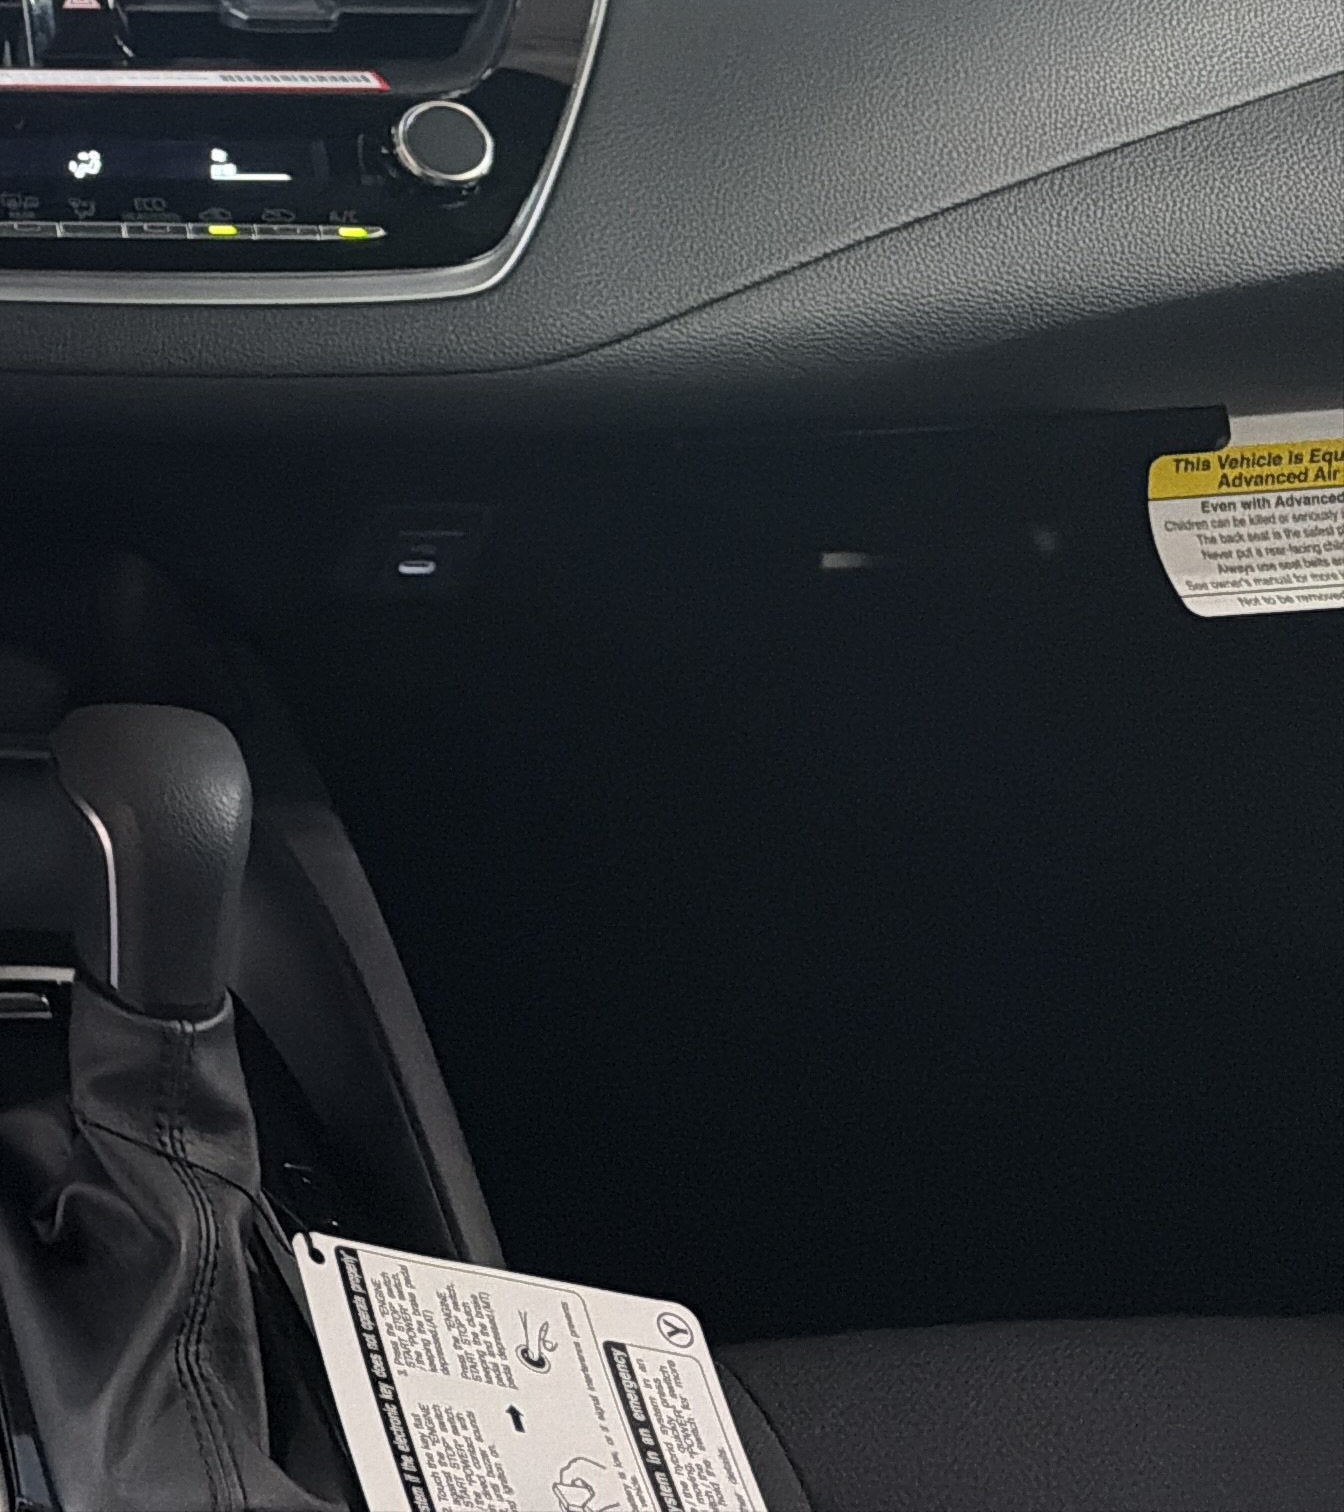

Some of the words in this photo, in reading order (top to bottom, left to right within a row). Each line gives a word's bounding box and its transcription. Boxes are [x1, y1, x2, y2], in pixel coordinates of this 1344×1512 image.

[1173, 457, 1211, 474] This
[1217, 452, 1283, 471] Vehicle
[1218, 468, 1309, 490] Advanced
[1312, 466, 1340, 483] Air
[1200, 500, 1236, 514] Even
[1240, 497, 1271, 510] with
[663, 1319, 691, 1342] Y
[379, 1381, 393, 1400] key
[612, 1348, 645, 1421] emergency
[639, 1428, 654, 1445] an
[431, 1471, 448, 1502] Touch
